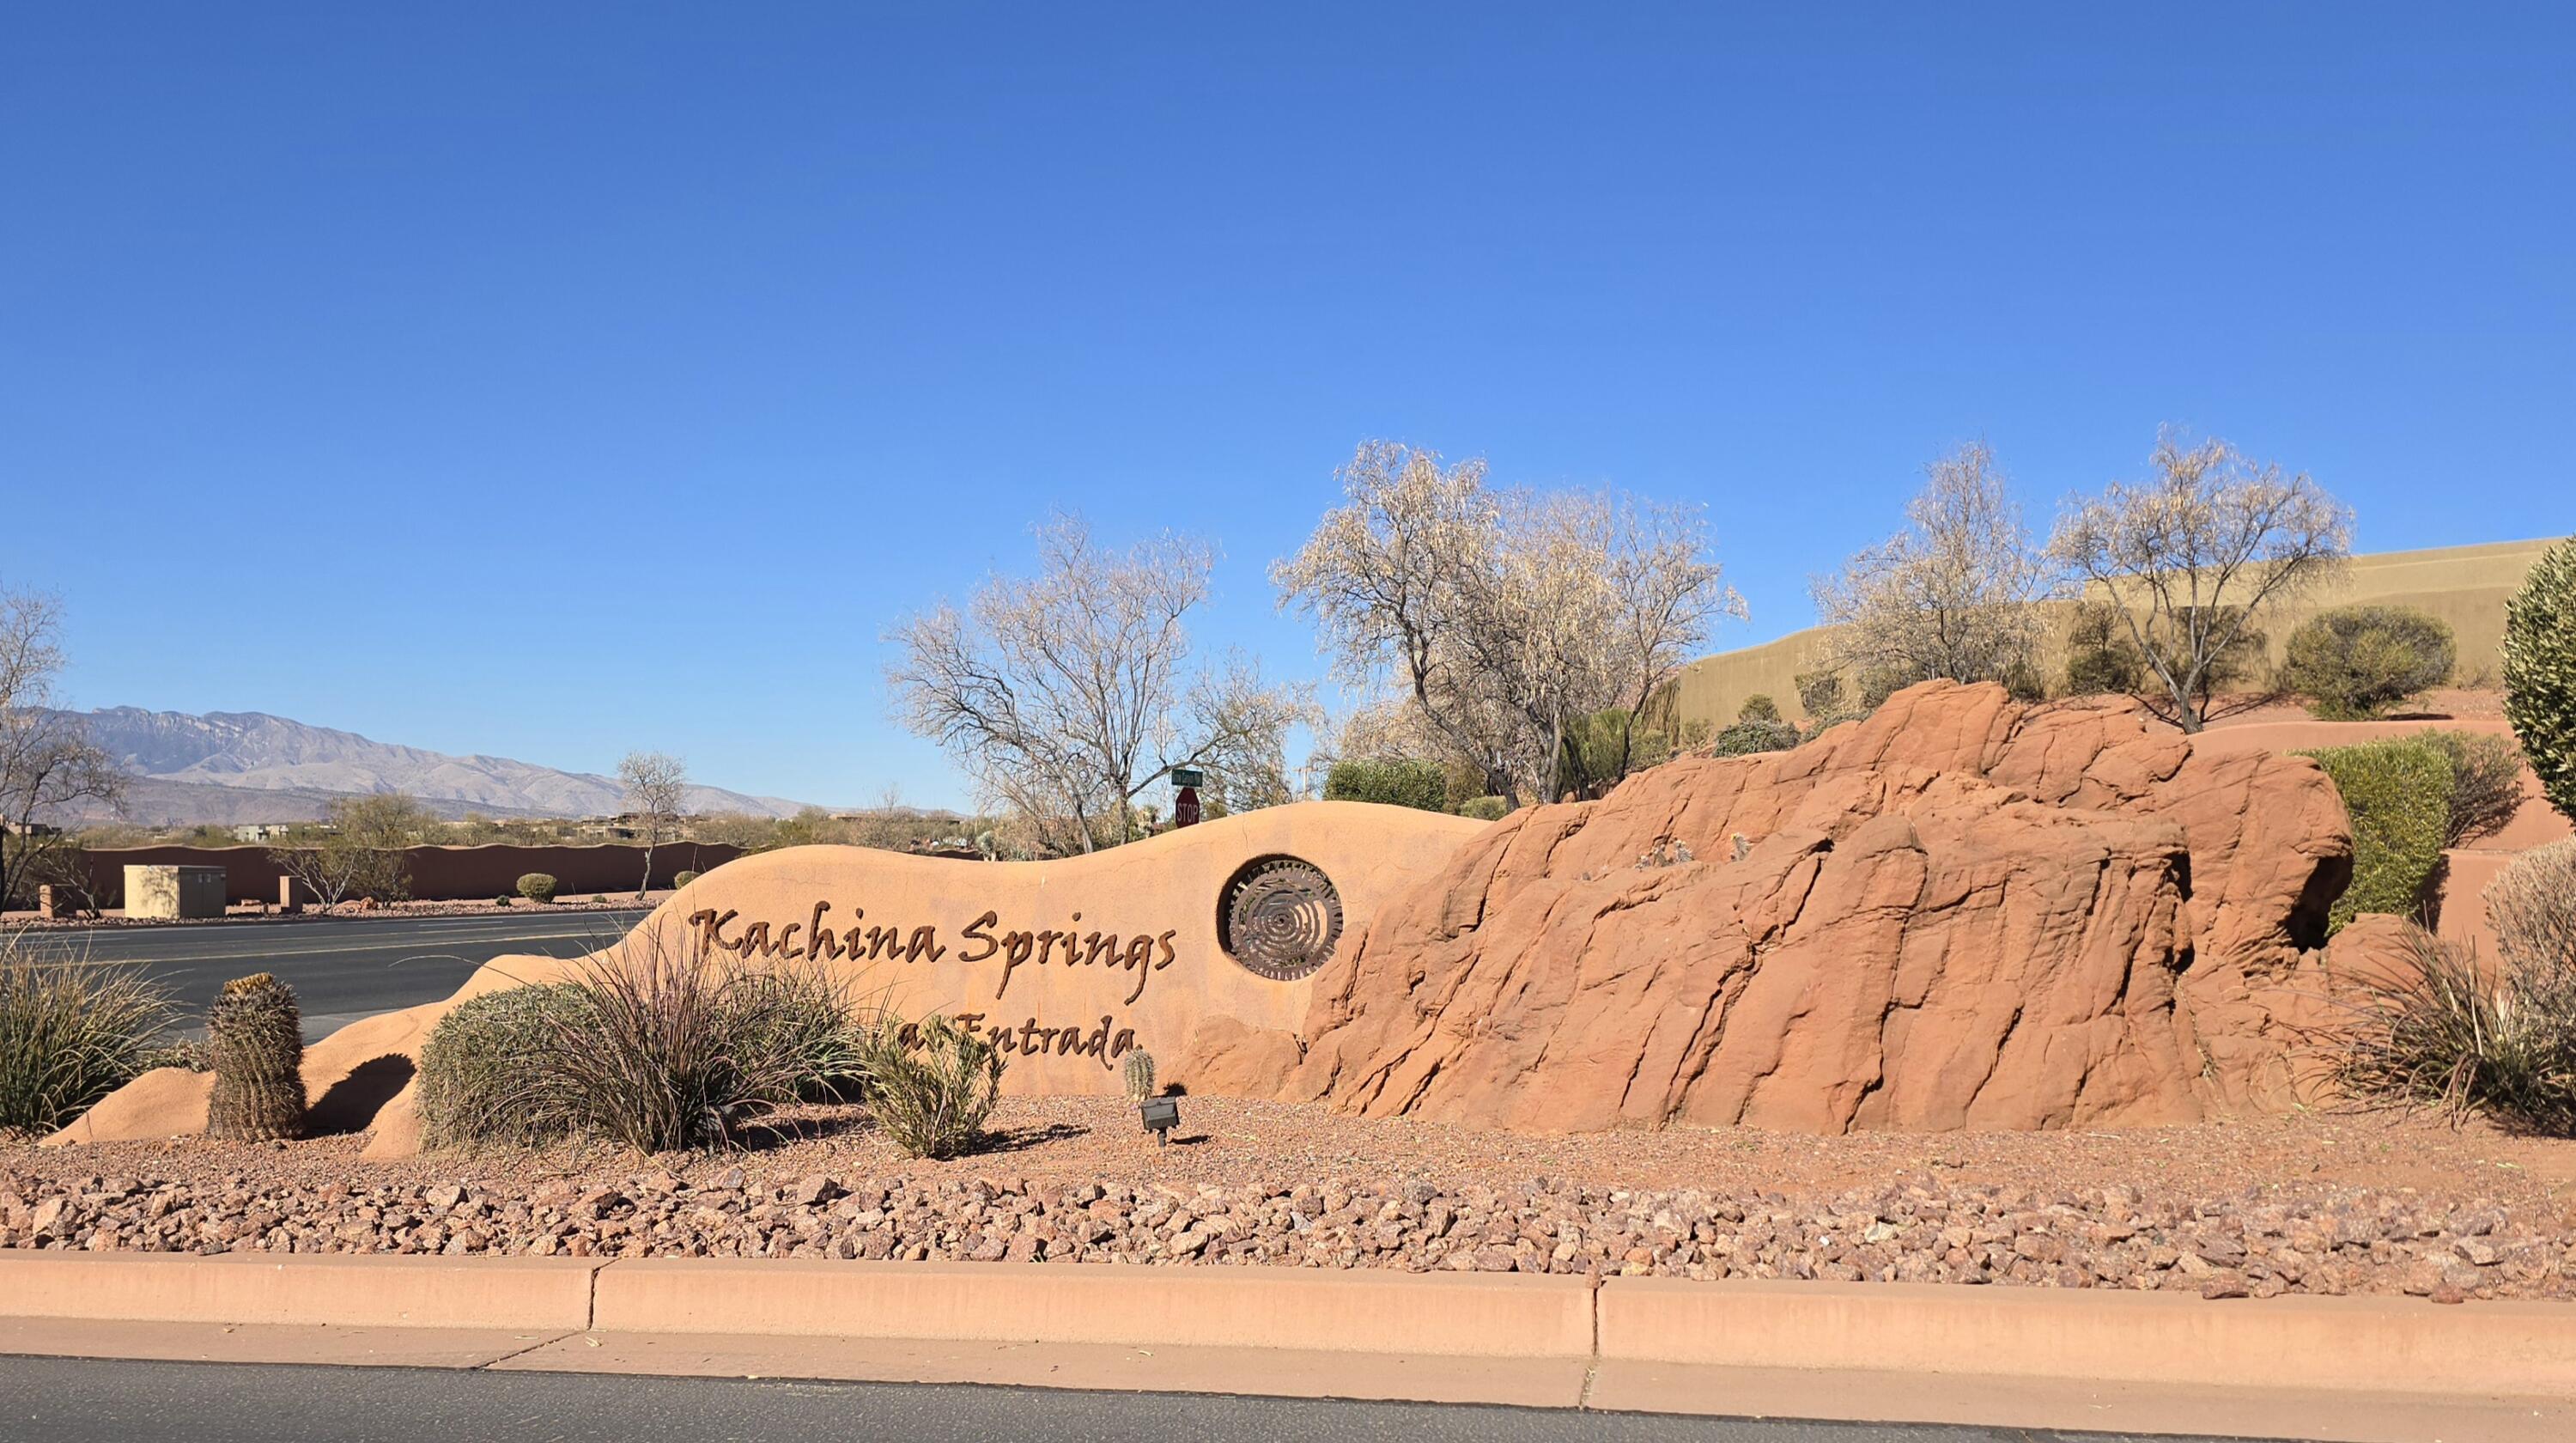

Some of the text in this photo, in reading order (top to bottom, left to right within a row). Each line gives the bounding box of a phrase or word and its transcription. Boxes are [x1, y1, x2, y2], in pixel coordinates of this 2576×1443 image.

[1176, 802, 1199, 823] STOP
[688, 900, 1176, 1006] Kachina Springs
